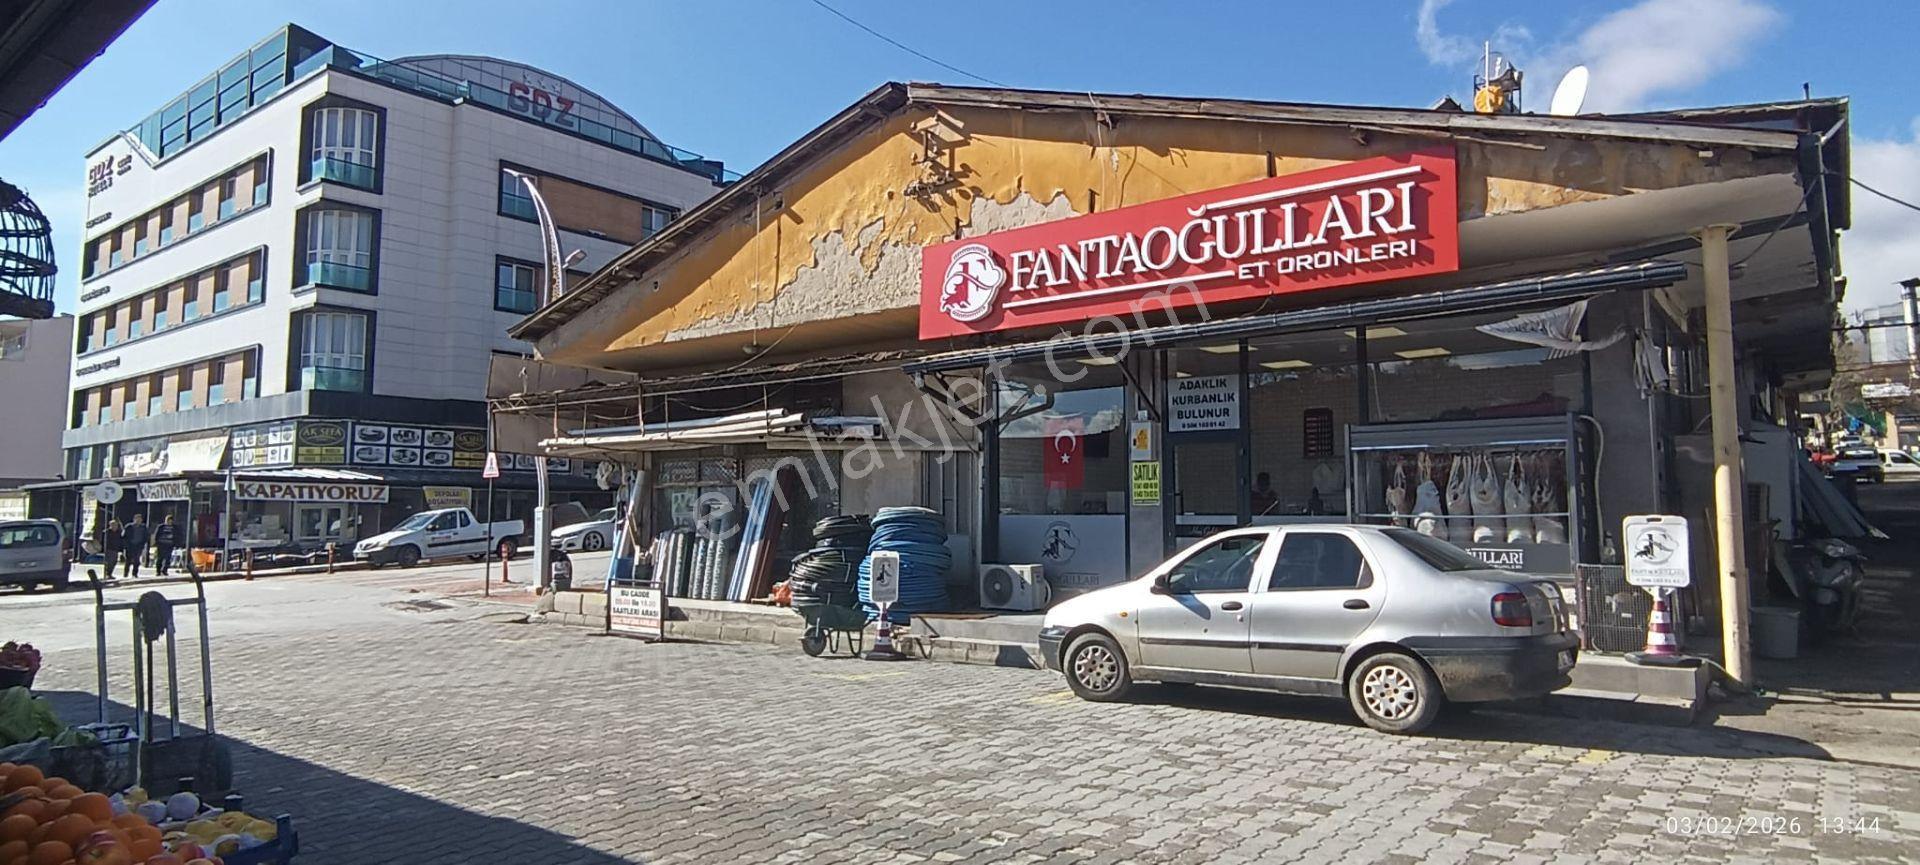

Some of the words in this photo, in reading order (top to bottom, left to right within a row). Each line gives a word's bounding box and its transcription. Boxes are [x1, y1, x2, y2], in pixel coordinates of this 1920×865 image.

[1009, 181, 1418, 293] FANTAOĞULLARI
[1238, 261, 1270, 280] ET
[1178, 378, 1227, 391] ADAKLIK
[1171, 392, 1235, 406] KURBANLIK
[1177, 407, 1230, 420] BULUNUR
[1133, 463, 1159, 481] SATILIK
[239, 484, 386, 501] KAPATIYORUZ
